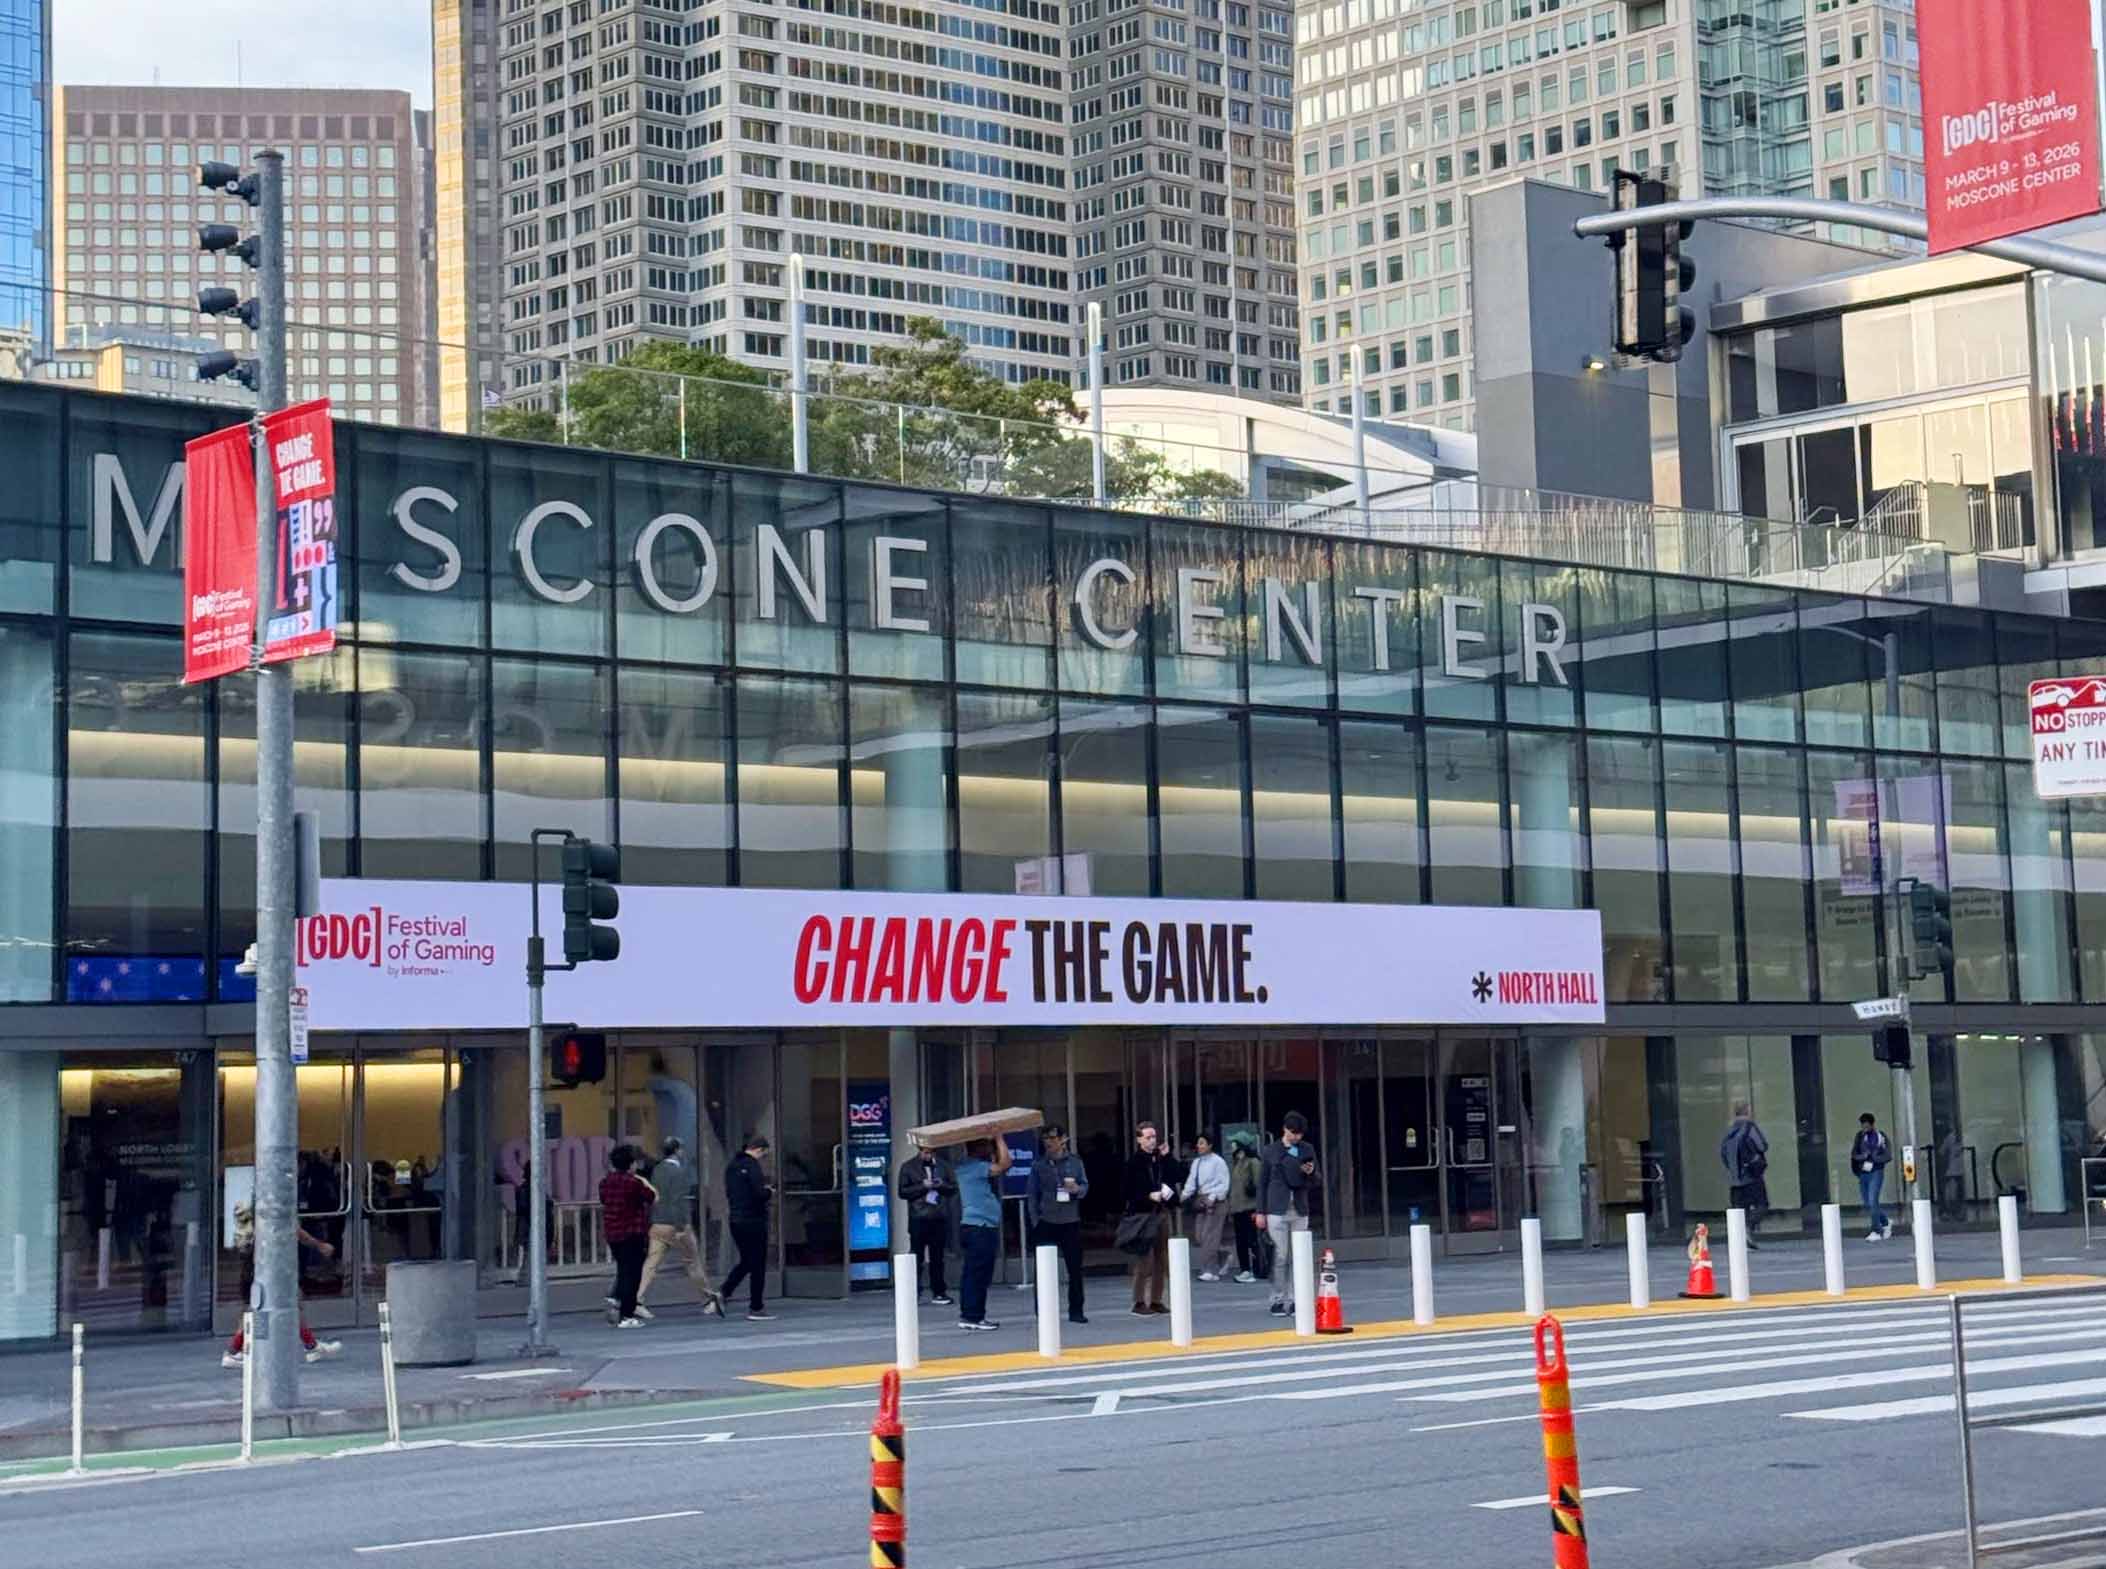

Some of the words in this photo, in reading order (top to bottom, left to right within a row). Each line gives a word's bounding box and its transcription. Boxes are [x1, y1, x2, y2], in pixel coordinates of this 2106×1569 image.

[1999, 90, 2056, 119] Festival
[2000, 116, 2017, 134] of
[2019, 104, 2078, 129] Gaming
[1942, 101, 1998, 156] [GDC]
[1945, 164, 1998, 191] MARCH
[1999, 160, 2010, 175] 9
[2042, 141, 2081, 164] 2026
[1946, 177, 2020, 212] MOSCONE
[2022, 162, 2081, 189] CENTER
[90, 454, 930, 632] MSCONE
[1074, 557, 1569, 684] CENTER
[2034, 712, 2065, 731] NO
[2041, 742, 2076, 762] ANY
[297, 906, 382, 967] [GDC]
[388, 915, 467, 937] Festival
[387, 939, 410, 961] of
[414, 938, 495, 966] Gaming
[793, 914, 1017, 1005] CHANGE
[1025, 919, 1113, 1004] THE
[1121, 920, 1269, 1005] GAME.
[387, 965, 399, 978] by
[1498, 971, 1555, 1005] NORTH
[1557, 972, 1598, 1005] HALL
